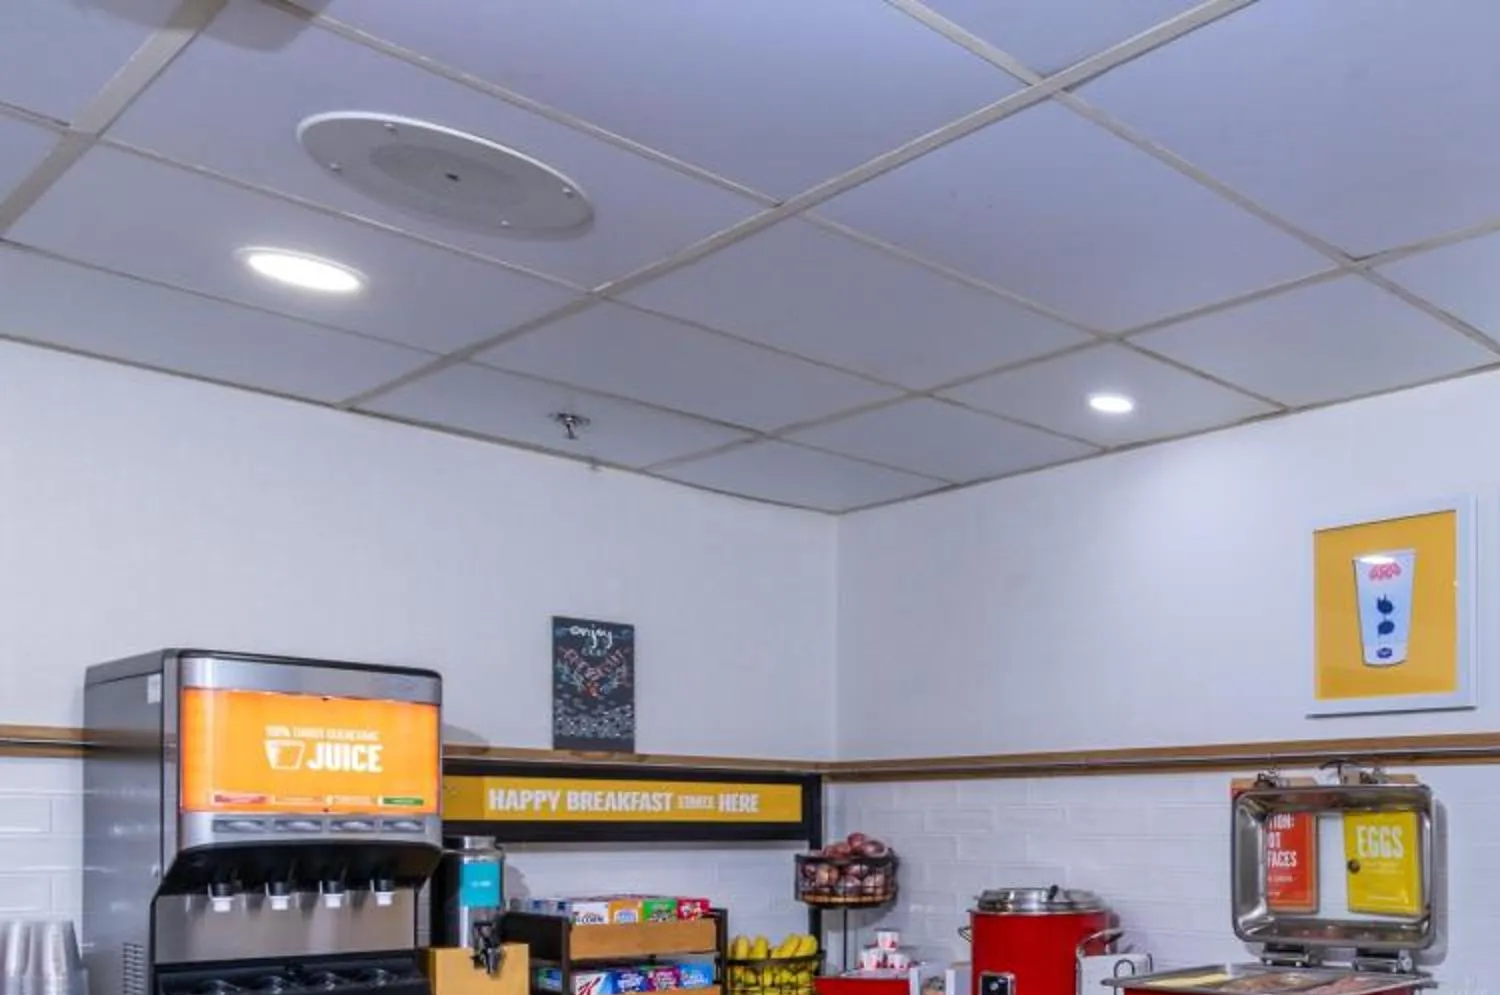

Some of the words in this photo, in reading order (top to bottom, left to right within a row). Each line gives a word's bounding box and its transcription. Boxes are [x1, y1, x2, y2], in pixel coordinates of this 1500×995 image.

[307, 741, 384, 773] JUICE
[488, 788, 561, 812] HAPPY
[567, 790, 672, 813] BREAKFAST
[718, 793, 759, 813] HERE
[1355, 825, 1404, 859] EGGS
